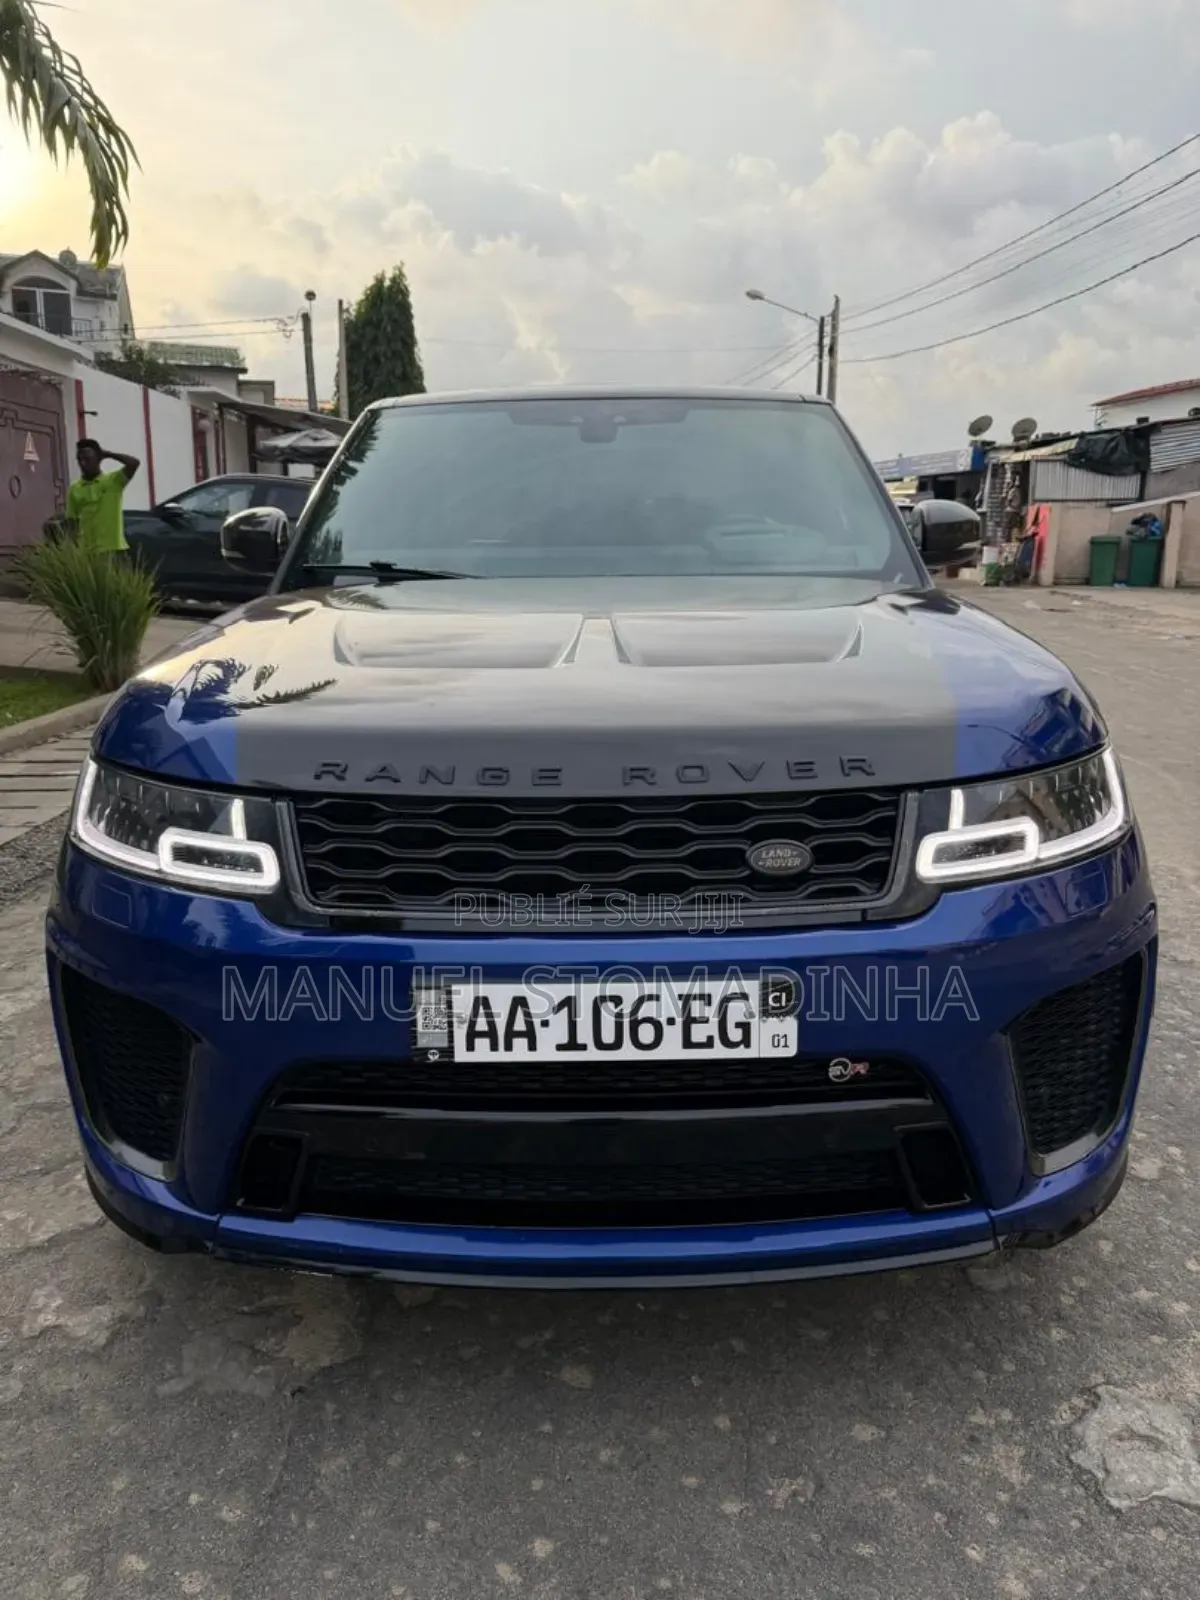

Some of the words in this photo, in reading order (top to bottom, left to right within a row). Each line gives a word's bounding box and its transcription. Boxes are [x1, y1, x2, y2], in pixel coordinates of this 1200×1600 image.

[313, 762, 563, 787] RANGE
[621, 755, 876, 787] ROVER
[771, 1033, 791, 1049] 01
